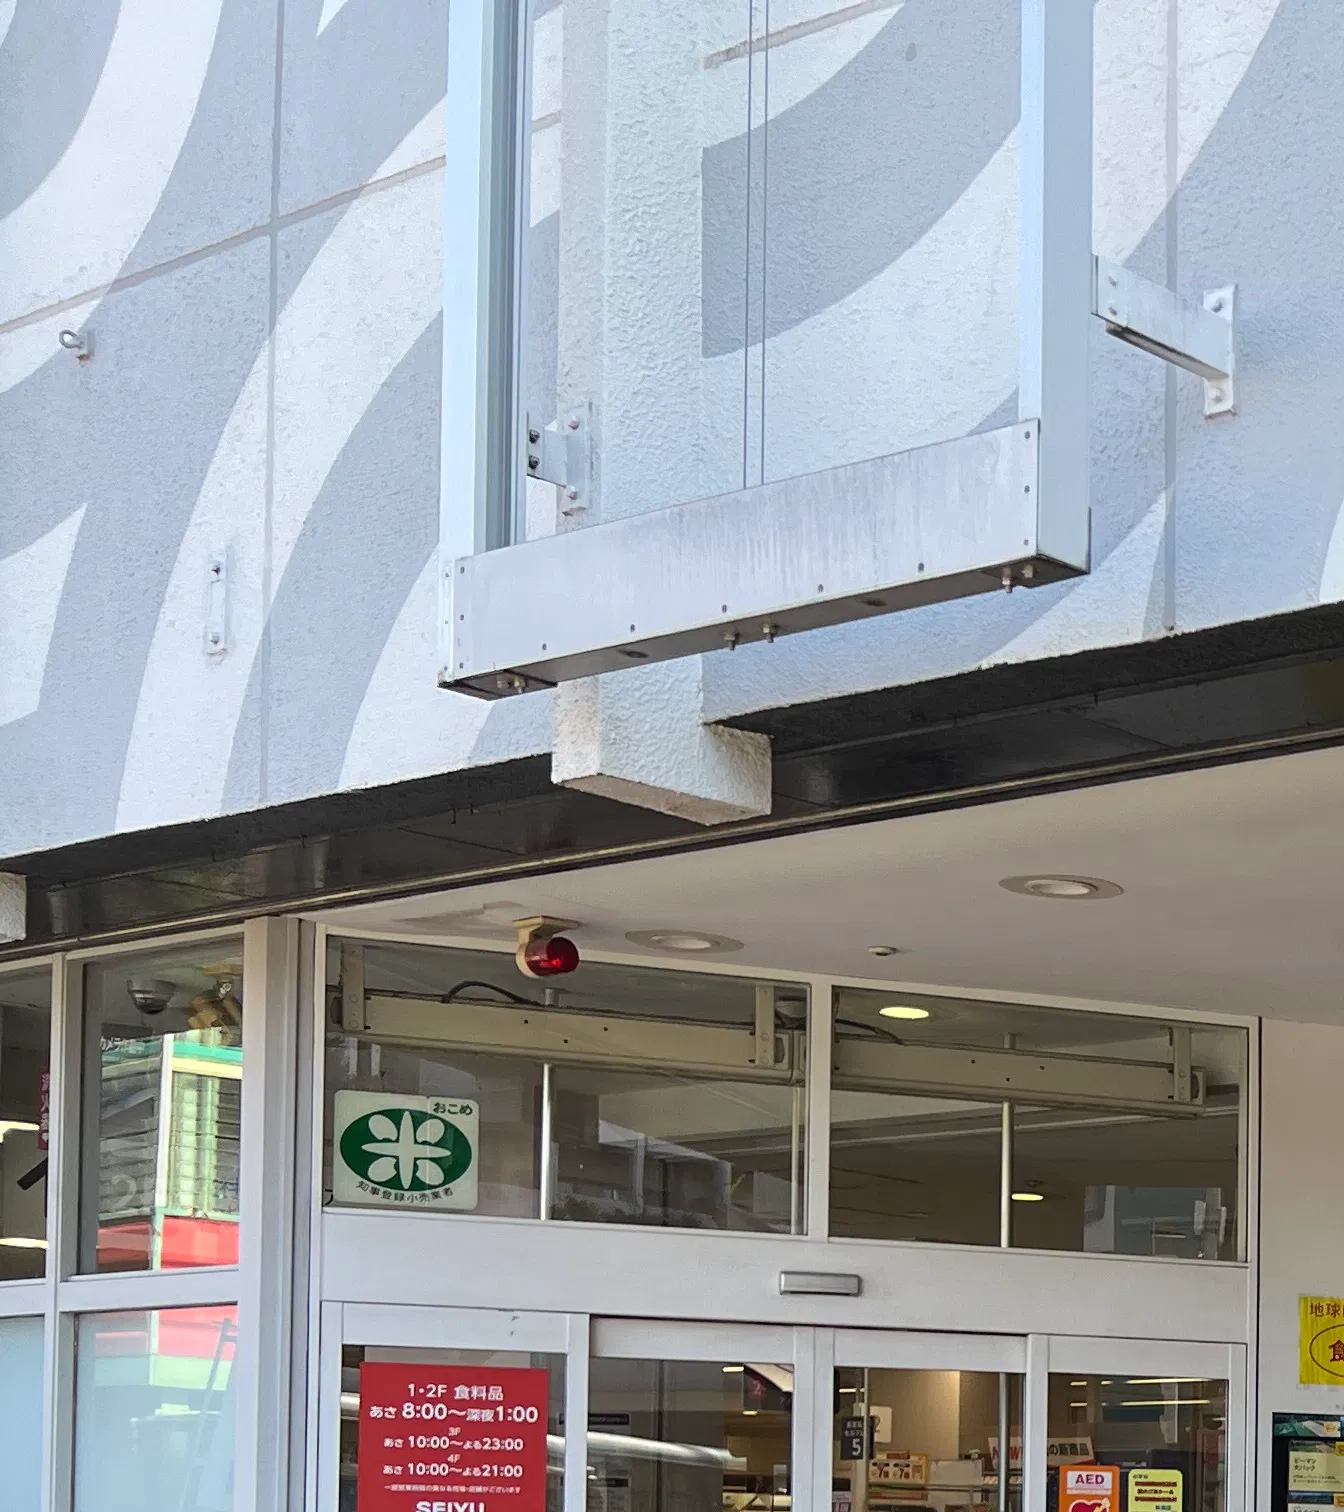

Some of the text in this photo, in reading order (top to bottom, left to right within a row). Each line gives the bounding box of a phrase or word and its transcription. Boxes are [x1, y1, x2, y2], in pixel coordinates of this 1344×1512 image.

[433, 1102, 473, 1116] おこめ
[453, 1384, 504, 1401] 食料品
[369, 1405, 397, 1419] あさ
[448, 1427, 461, 1436] 3F
[383, 1438, 404, 1449] あさ
[447, 1454, 461, 1463] 4F
[382, 1465, 404, 1476] あさ
[1075, 1473, 1105, 1485] AED
